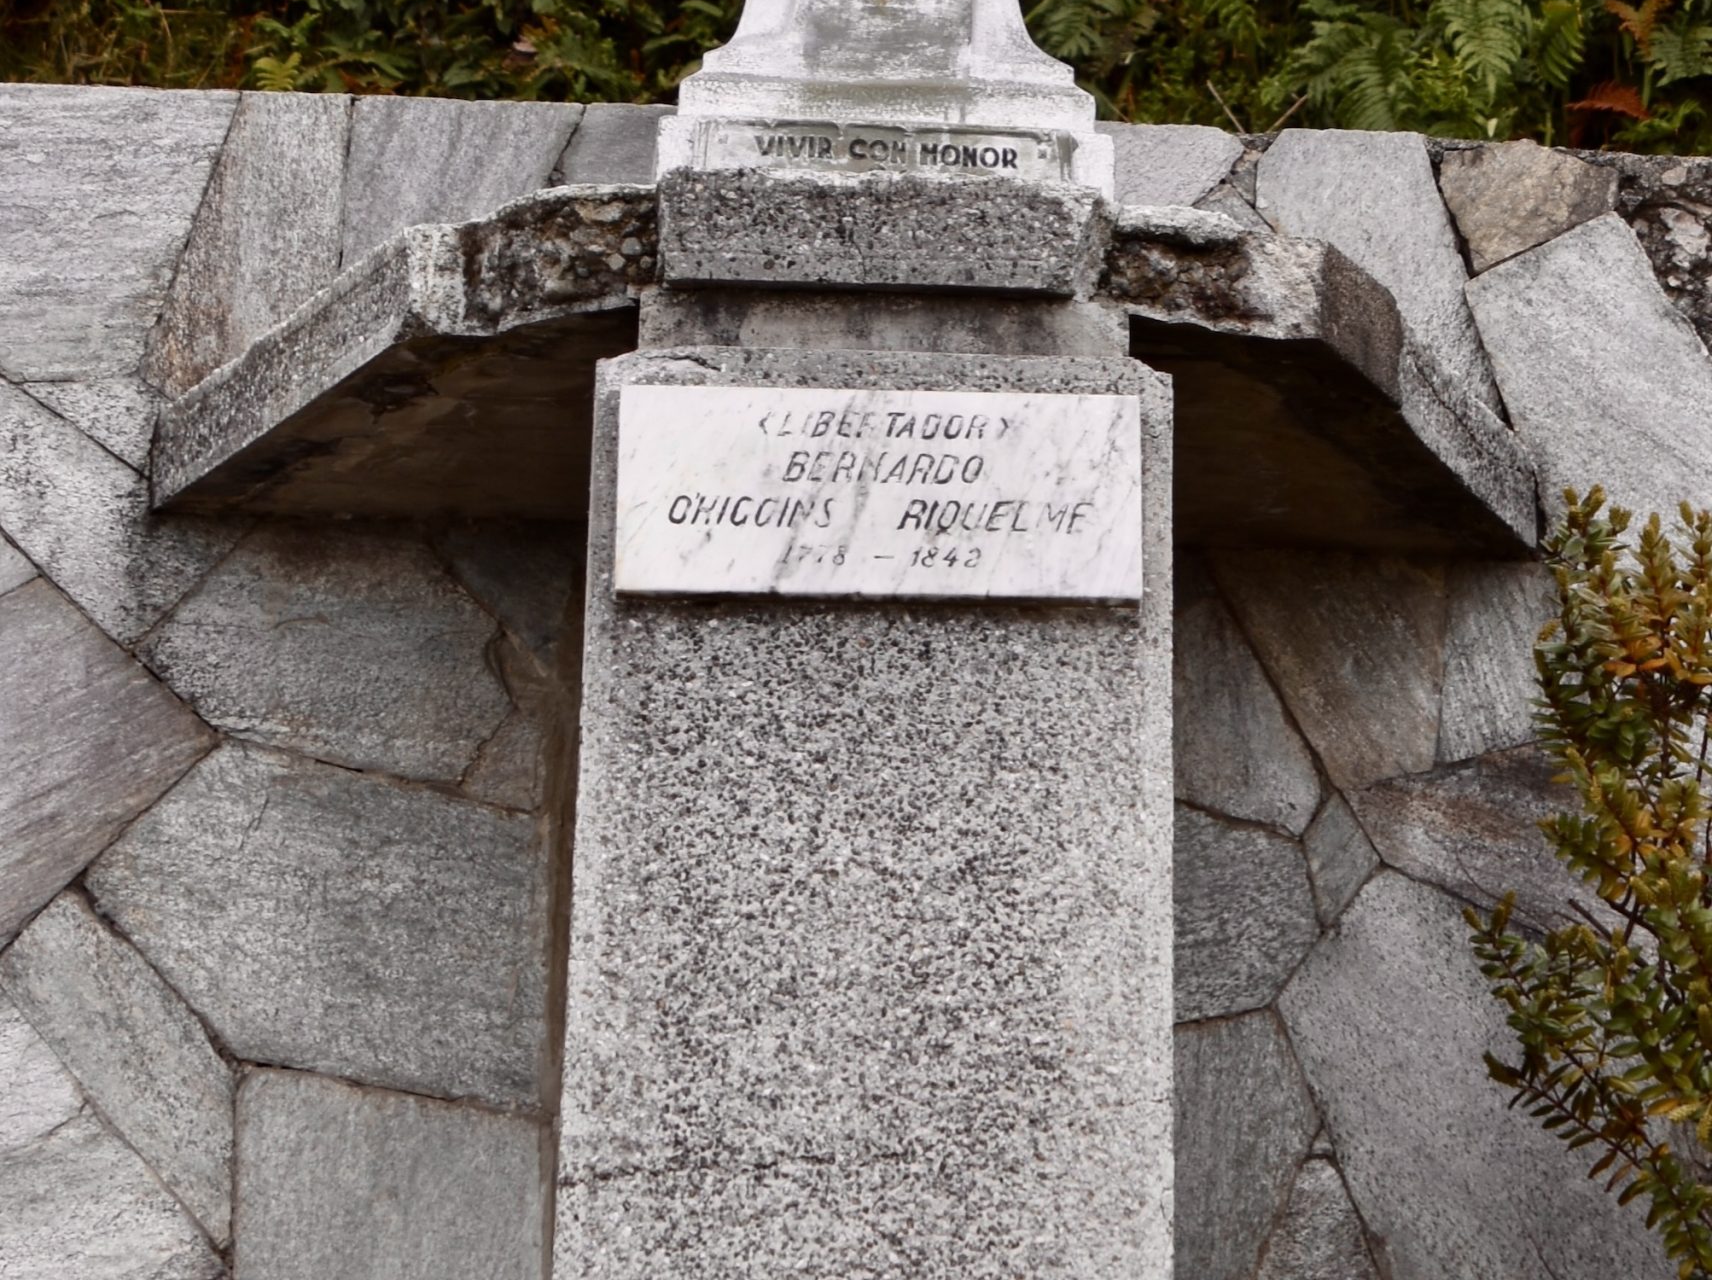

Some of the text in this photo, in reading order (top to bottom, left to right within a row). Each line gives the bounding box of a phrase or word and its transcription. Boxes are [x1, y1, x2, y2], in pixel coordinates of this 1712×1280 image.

[754, 134, 833, 160] VIVIR
[848, 138, 908, 165] CON
[919, 141, 1019, 170] HONOR
[781, 450, 985, 485] BERNARDO
[910, 546, 982, 569] 1842
